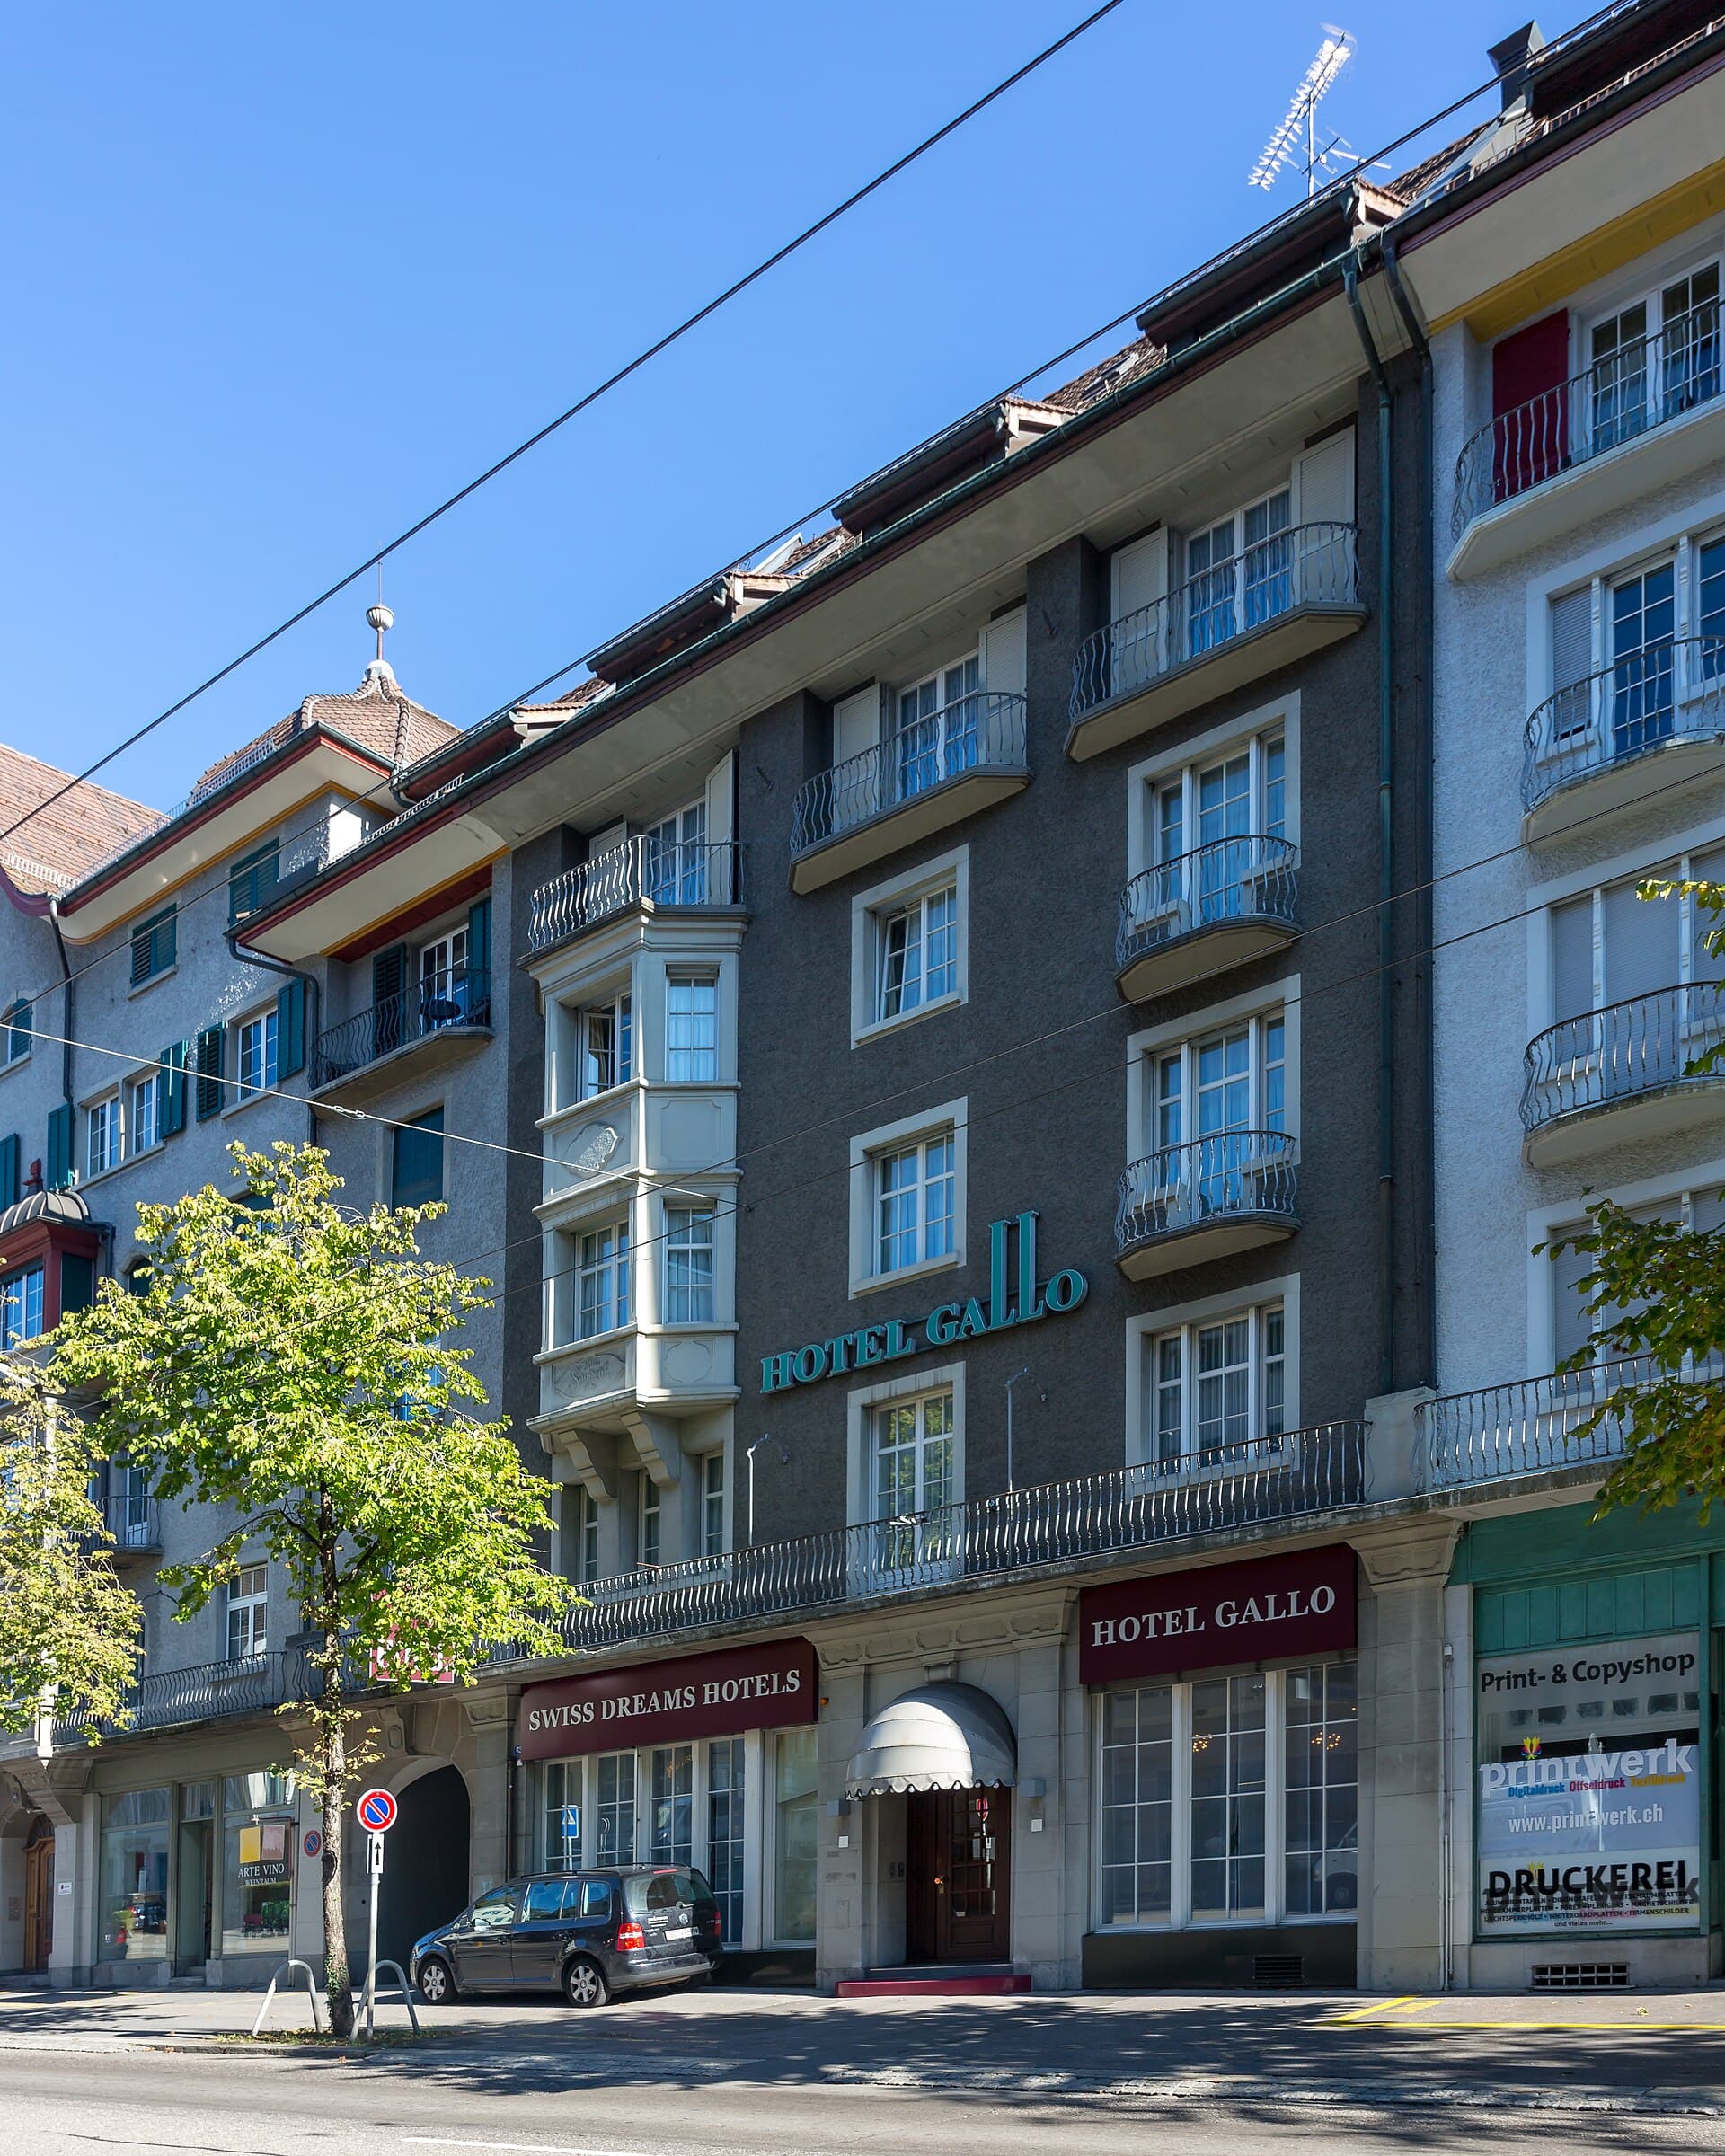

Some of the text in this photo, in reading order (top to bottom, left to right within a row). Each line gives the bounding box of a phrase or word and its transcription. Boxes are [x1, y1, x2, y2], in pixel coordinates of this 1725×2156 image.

[760, 1209, 1088, 1393] HOTEL GALLO
[1092, 1586, 1336, 1647] HOTEL GALLO
[1481, 1653, 1695, 1693] Print- & Copyshop
[528, 1669, 801, 1731] SWISS DREAMS HOTELS
[1479, 1738, 1693, 1798] printwerk
[1508, 1782, 1565, 1798] Digitaldruck
[1570, 1777, 1625, 1792] Offsetdruck
[237, 1863, 285, 1878] ARTE VINO
[244, 1877, 277, 1886] WEINRAUM
[1489, 1860, 1685, 1898] DRUCKEREI
[1549, 1911, 1623, 1920] WHITEBOARDPLATTEN
[1629, 1907, 1690, 1916] FIRMENSCHILDER
